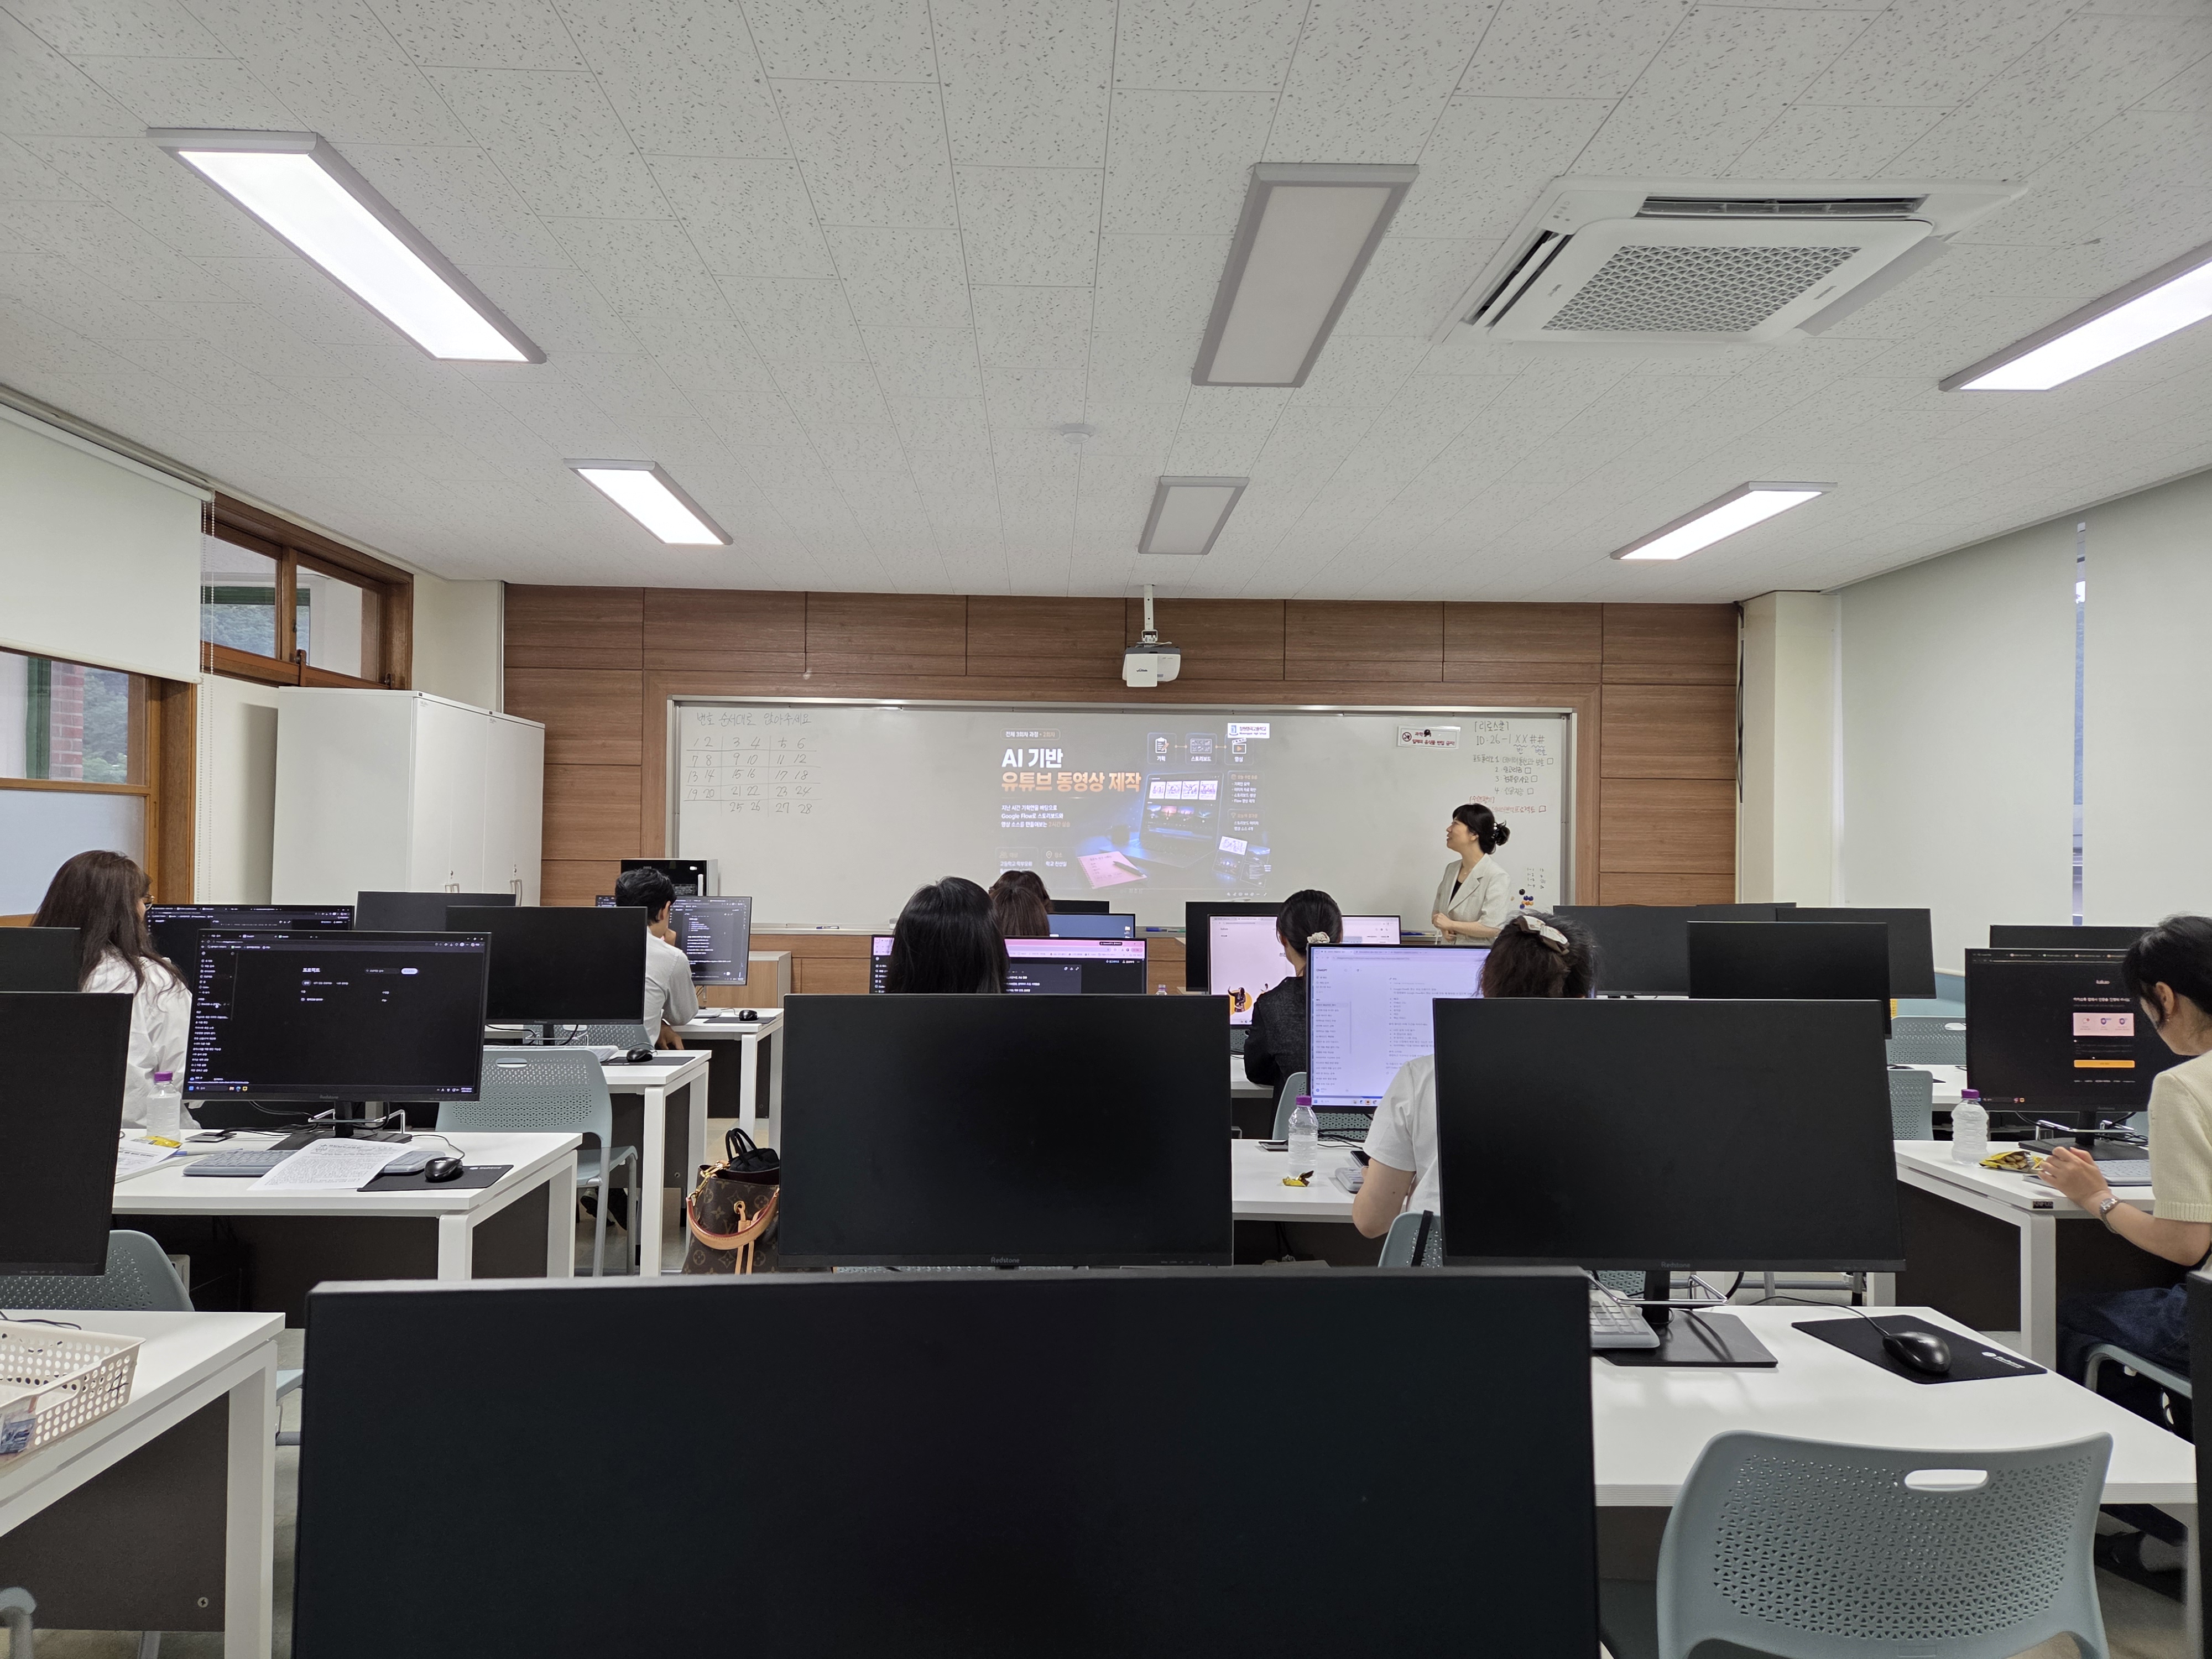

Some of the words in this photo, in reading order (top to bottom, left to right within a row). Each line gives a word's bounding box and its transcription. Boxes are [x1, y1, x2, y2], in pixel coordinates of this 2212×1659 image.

[697, 712, 715, 726] 번호
[718, 712, 757, 727] 순서대로
[764, 712, 812, 726] 앉아주세요
[704, 737, 713, 747] 2
[733, 737, 740, 747] 3
[750, 737, 761, 749] 4
[778, 737, 787, 748] 5
[797, 738, 806, 749] 6
[692, 755, 698, 767] 7
[706, 755, 712, 766] 8
[733, 753, 740, 765] 9
[747, 754, 758, 765] 10
[777, 755, 785, 765] 11
[794, 754, 806, 764] 12
[1001, 748, 1023, 768] AI
[1028, 748, 1063, 768] 기반
[687, 770, 698, 782] 13
[705, 769, 714, 782] 14
[732, 769, 744, 779] 15
[747, 768, 755, 779] 16
[775, 770, 788, 781] 17
[795, 770, 808, 780] 18
[1001, 771, 1052, 792] 유튜브
[1056, 771, 1105, 792] 동영상
[1108, 771, 1141, 792] 제작
[687, 789, 698, 800] 19
[703, 789, 714, 799] 20
[731, 786, 741, 797] 21
[747, 786, 760, 796] 22
[776, 786, 788, 797] 23
[795, 786, 812, 797] 24
[730, 802, 745, 813] 25
[750, 800, 760, 811] 26
[776, 802, 790, 813] 27
[798, 804, 812, 814] 28
[107, 1371, 129, 1400] 4
